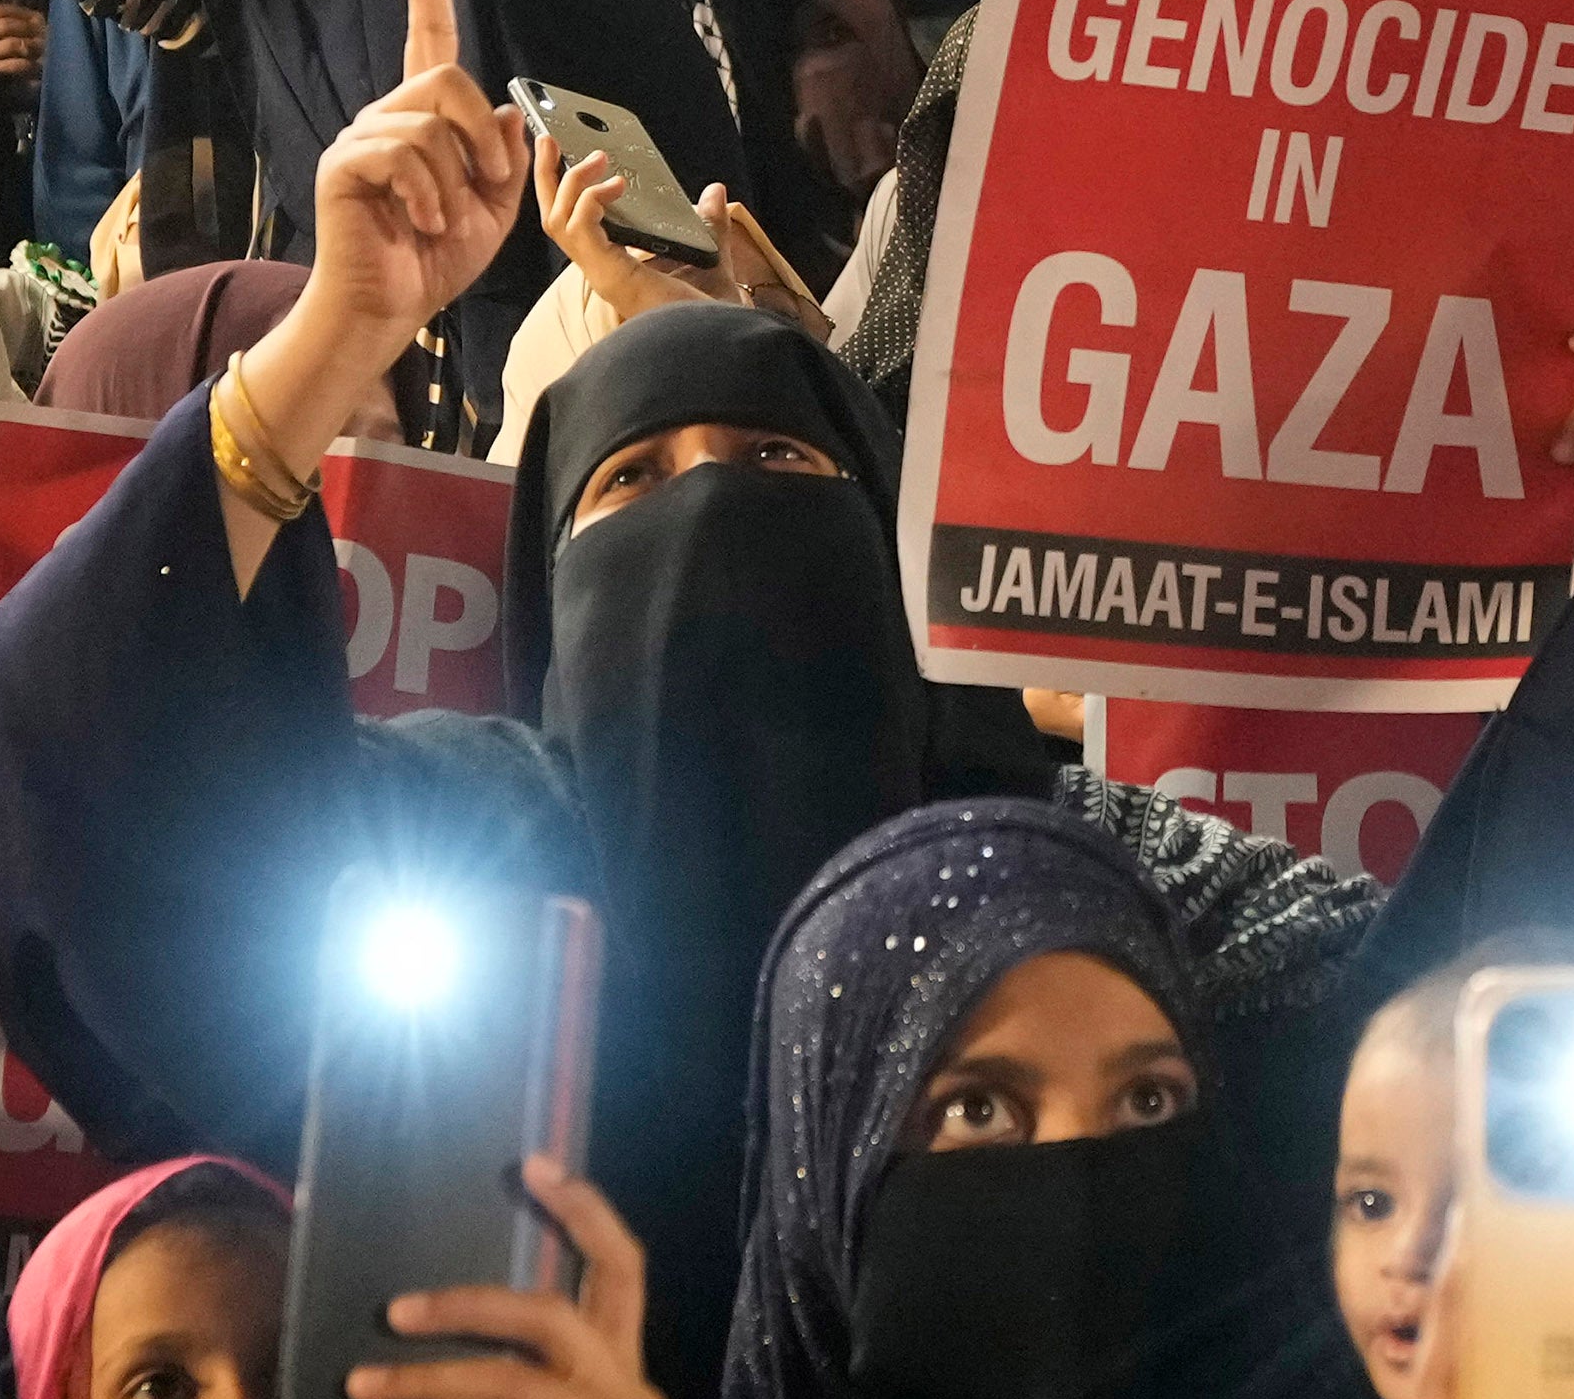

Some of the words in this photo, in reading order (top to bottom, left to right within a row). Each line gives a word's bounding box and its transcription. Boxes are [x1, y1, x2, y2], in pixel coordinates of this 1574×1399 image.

[1246, 128, 1343, 228] IN
[1002, 250, 1527, 501] GAZA
[960, 543, 1534, 645] JAMAAT-E-ISLAMI
